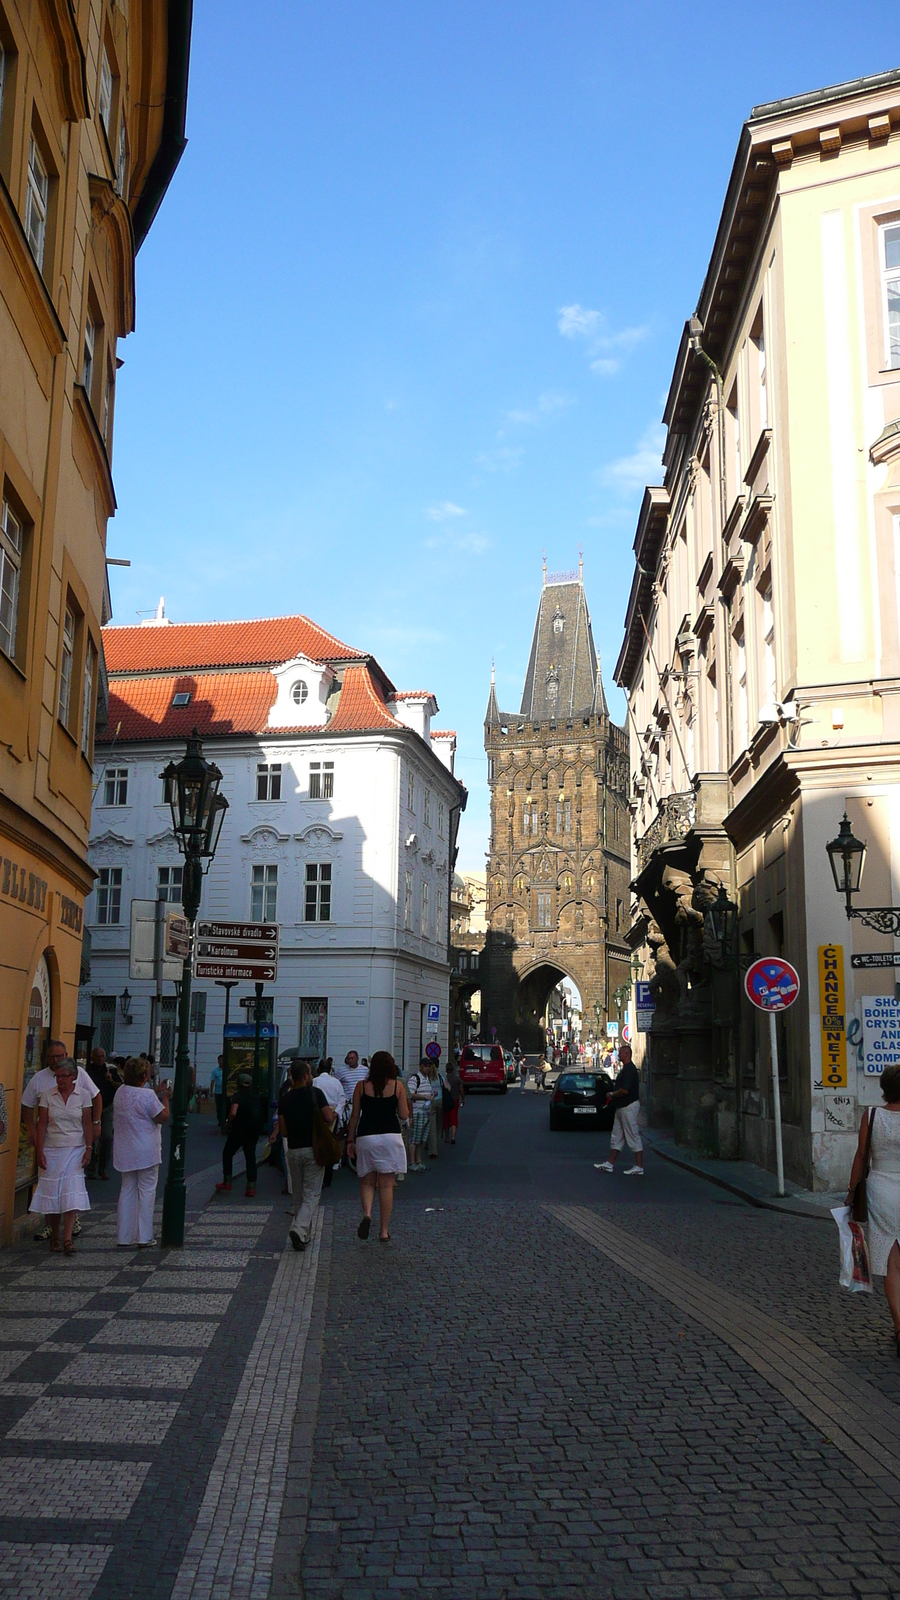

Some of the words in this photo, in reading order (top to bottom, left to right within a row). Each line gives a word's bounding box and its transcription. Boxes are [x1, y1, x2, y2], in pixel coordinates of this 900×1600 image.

[0, 855, 48, 913] ELLERY
[212, 925, 240, 936] Stavovské
[242, 927, 262, 938] divadlo
[211, 945, 238, 956] Karolinum
[197, 964, 223, 976] Turistické
[225, 966, 252, 977] informace
[823, 948, 840, 1015] CHANGE
[429, 1005, 438, 1017] P
[826, 1032, 842, 1084] NETTO
[867, 1064, 888, 1073] OU
